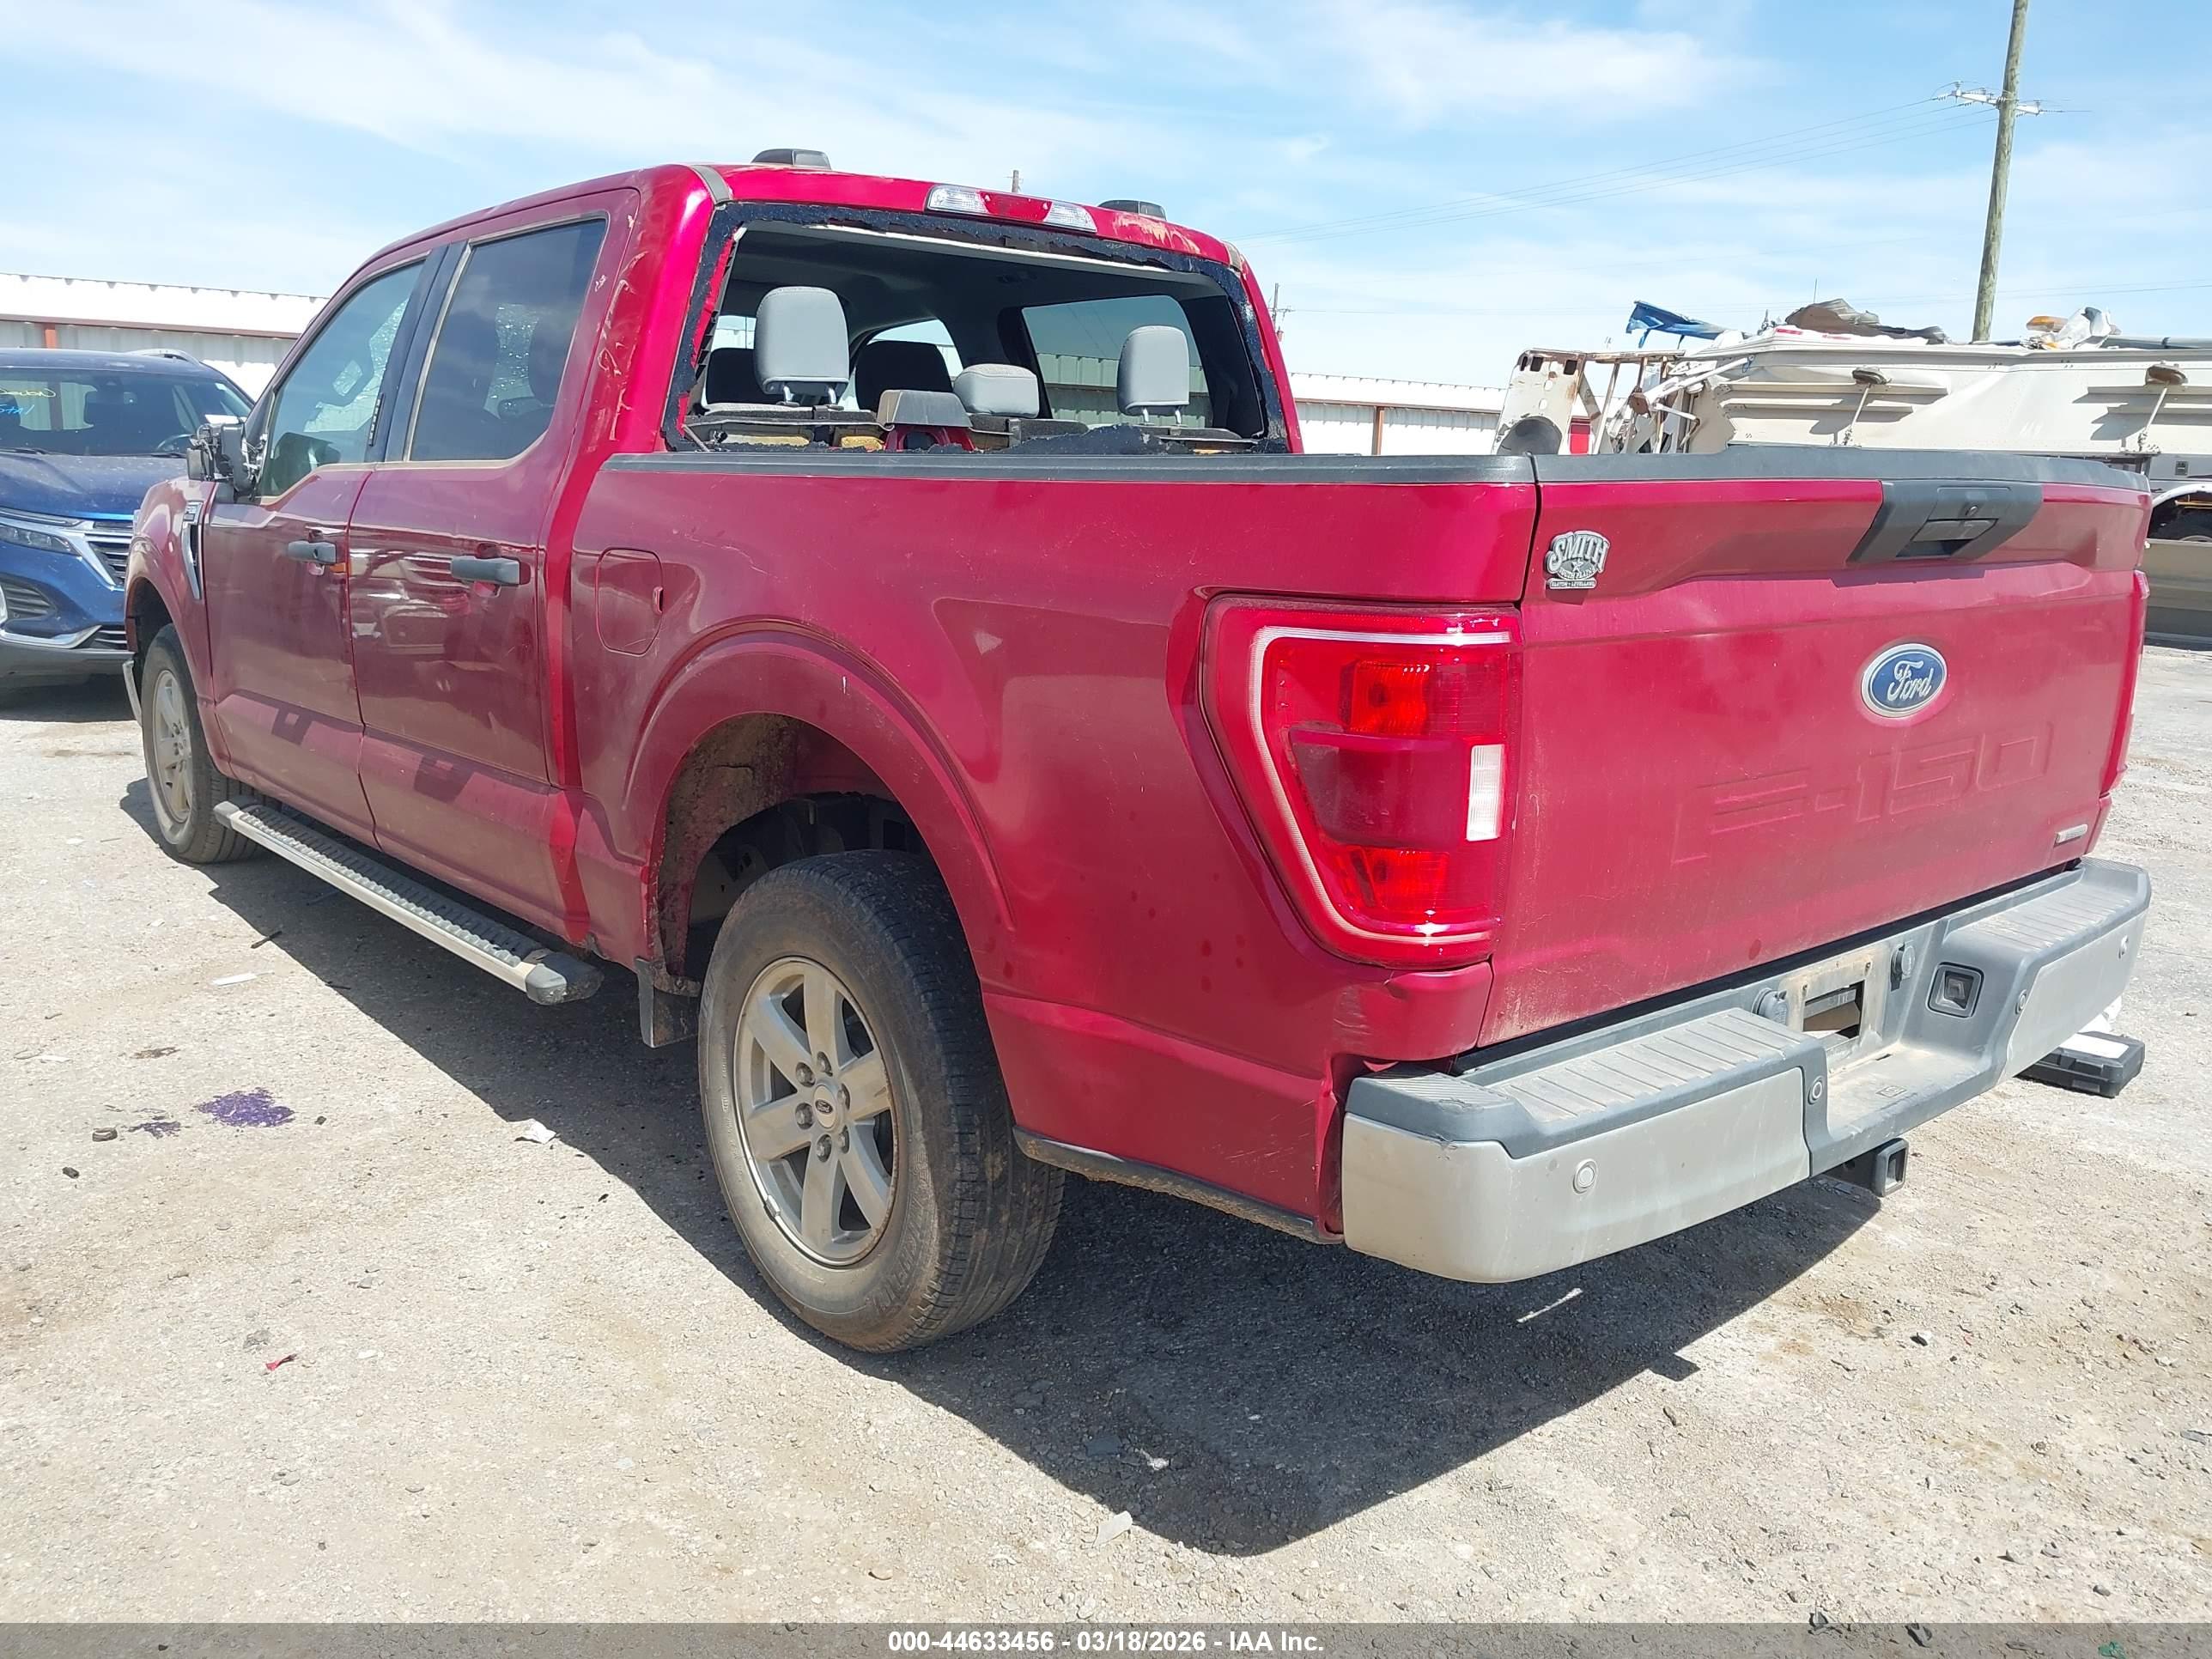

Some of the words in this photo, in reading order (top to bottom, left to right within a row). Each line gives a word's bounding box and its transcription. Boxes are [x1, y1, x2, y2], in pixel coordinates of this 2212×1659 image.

[1548, 533, 1609, 574] SMITH
[1887, 660, 1935, 702] Ford
[1670, 720, 2053, 866] F-150
